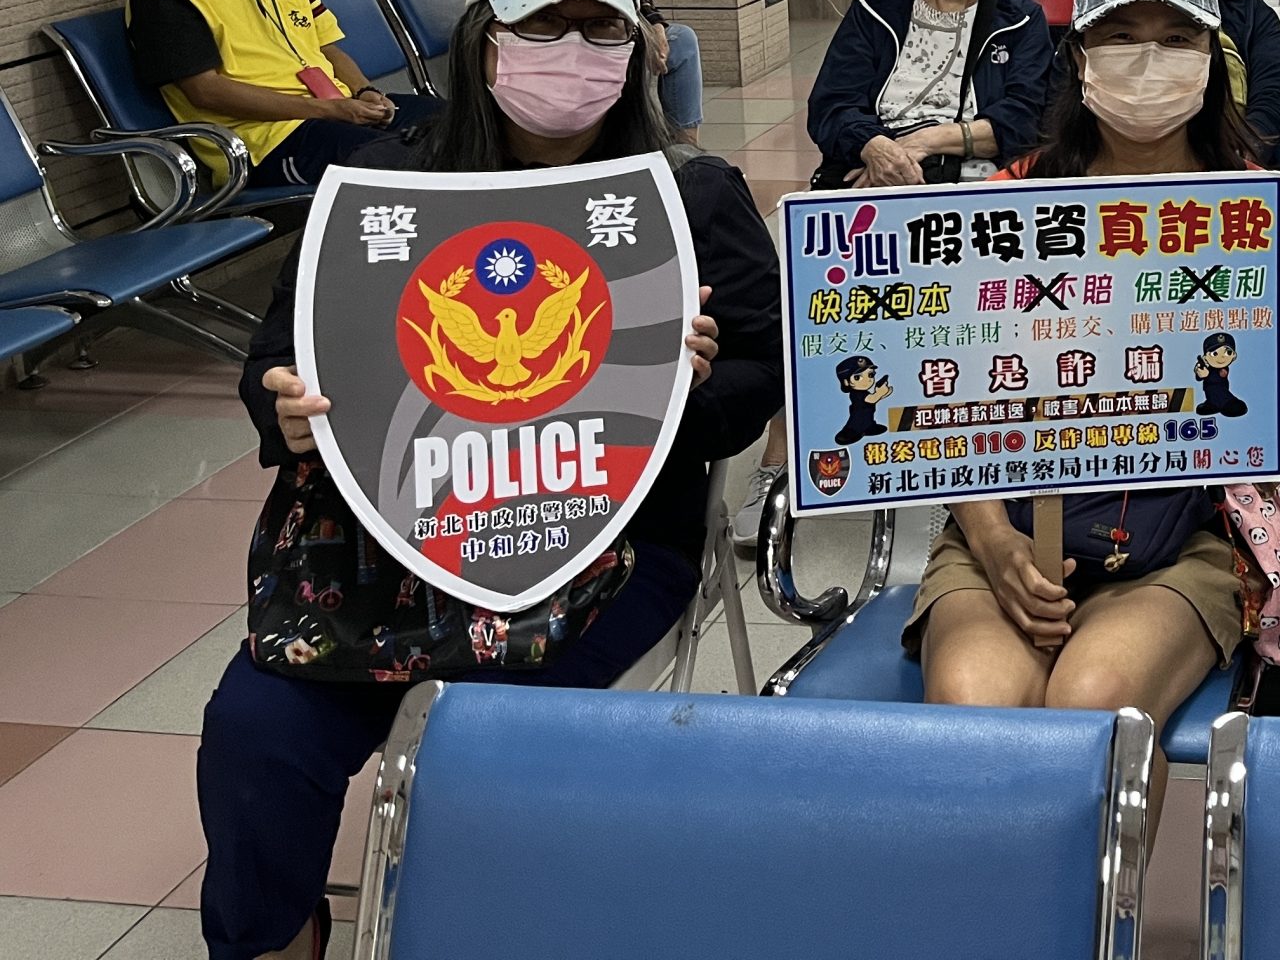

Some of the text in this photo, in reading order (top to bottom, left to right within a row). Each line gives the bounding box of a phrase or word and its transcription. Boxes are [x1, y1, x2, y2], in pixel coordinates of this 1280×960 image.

[360, 193, 638, 263] 警 察
[906, 203, 1087, 266] 假投資
[1098, 198, 1273, 258] 真詐欺
[918, 344, 1164, 397] 皆是詐騙
[413, 418, 608, 508] POLICE
[819, 478, 842, 489] POLICE
[414, 494, 610, 539] 新北市政府警察局
[461, 528, 569, 563] 中和分局
